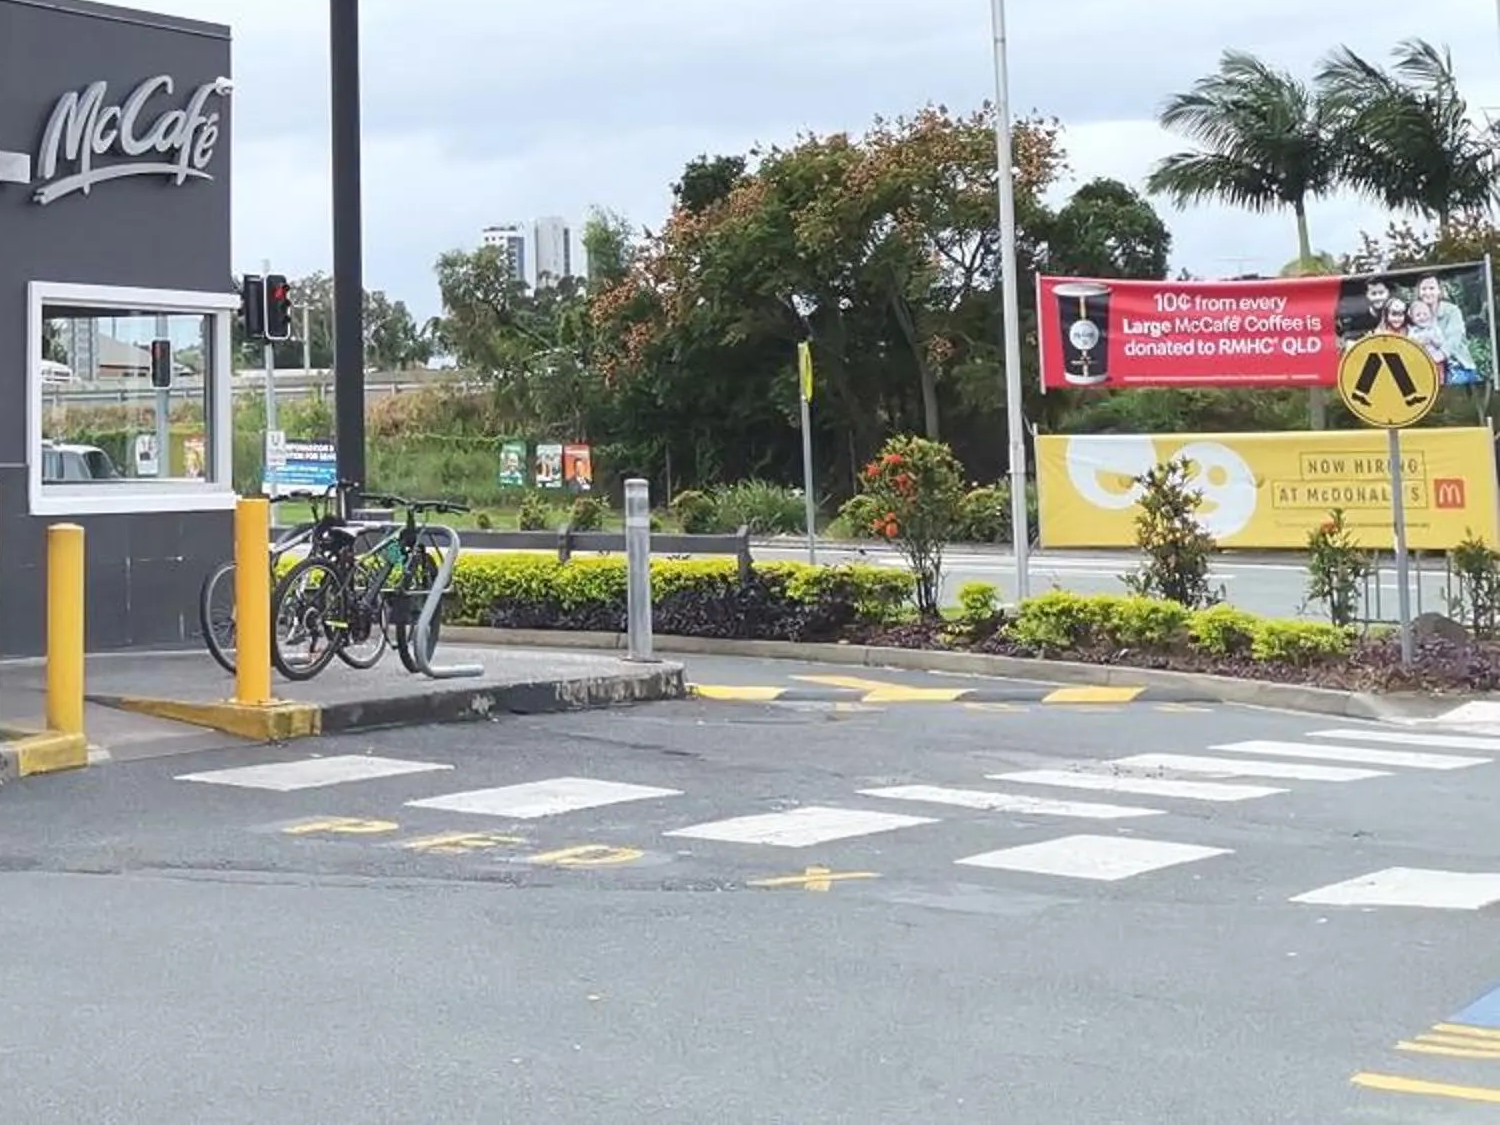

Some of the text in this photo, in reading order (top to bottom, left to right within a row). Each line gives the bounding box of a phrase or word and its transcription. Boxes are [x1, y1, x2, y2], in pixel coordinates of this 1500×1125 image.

[1154, 292, 1287, 313] 10¢ from every
[1122, 318, 1172, 338] Large
[1244, 314, 1304, 332] Coffee
[1306, 314, 1321, 332] is
[1124, 339, 1194, 356] donated
[1197, 339, 1216, 355] to
[1282, 336, 1322, 356] QLD
[1308, 458, 1418, 474] NOW HIRIG
[1279, 486, 1298, 502] AT
